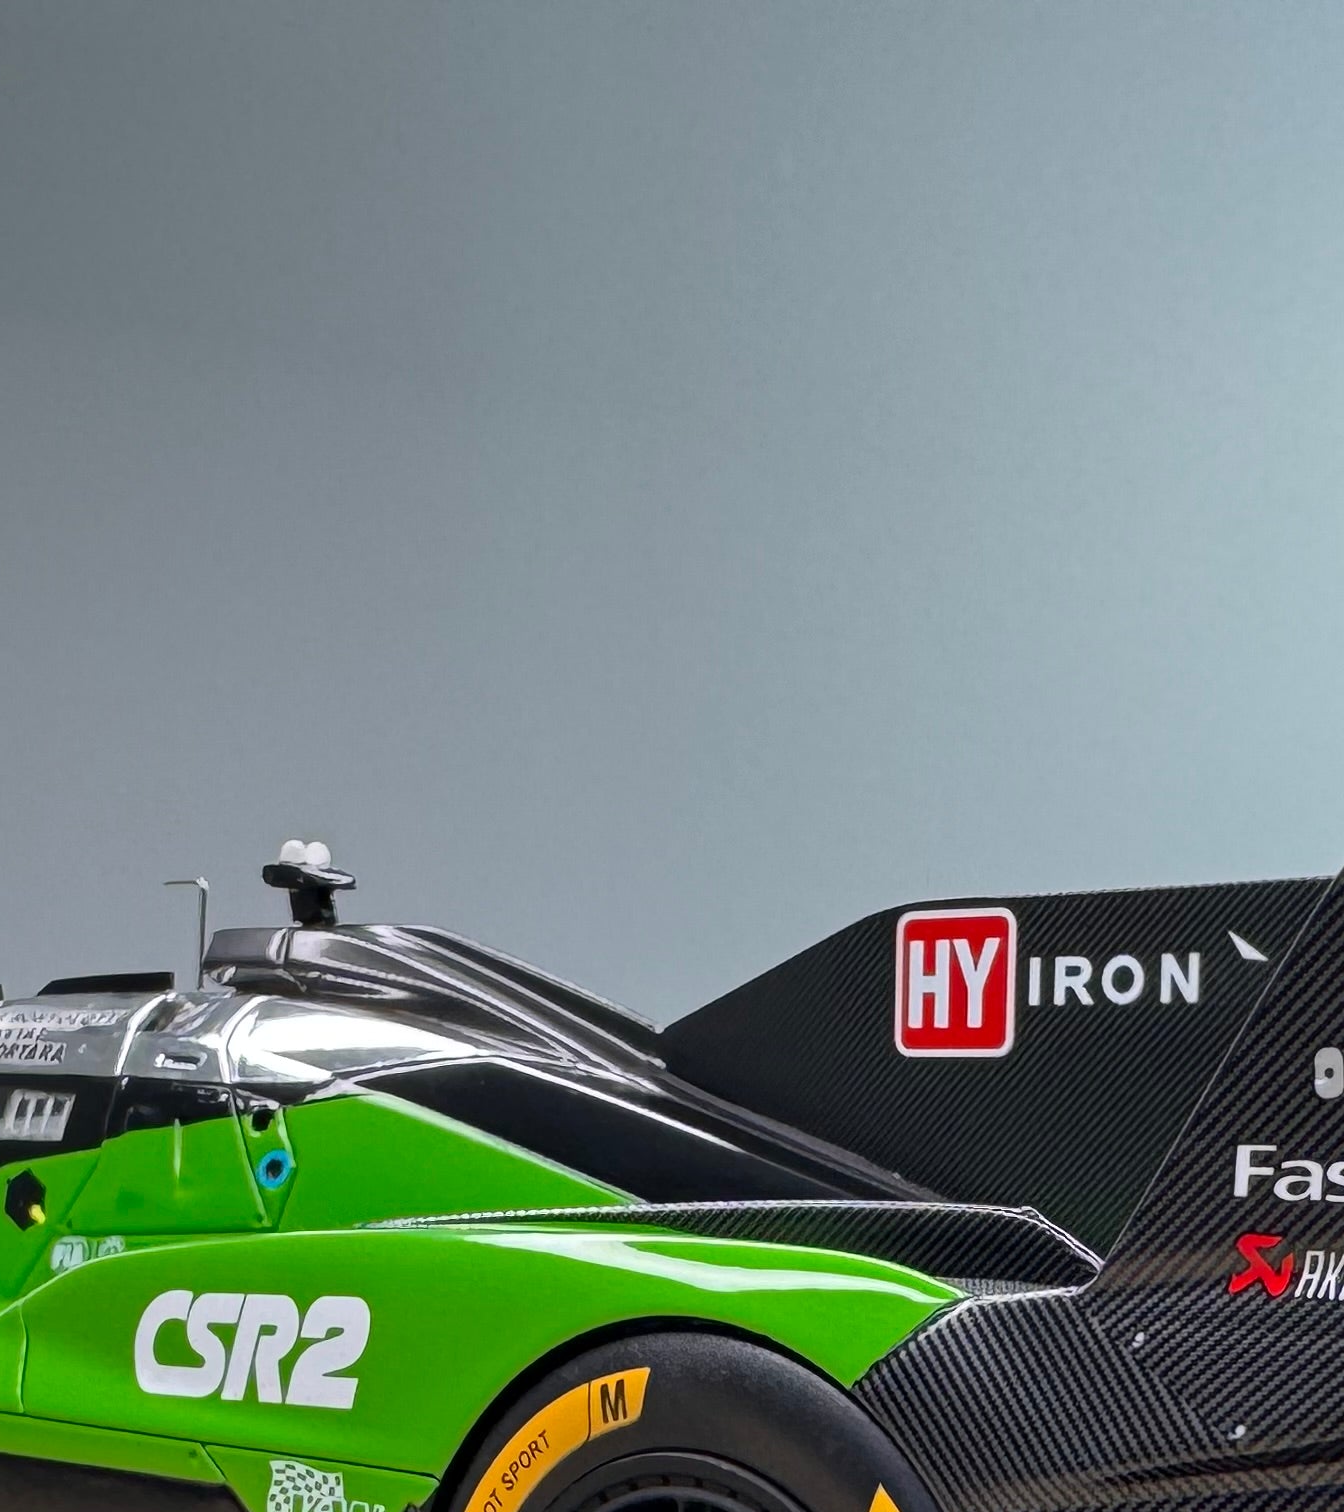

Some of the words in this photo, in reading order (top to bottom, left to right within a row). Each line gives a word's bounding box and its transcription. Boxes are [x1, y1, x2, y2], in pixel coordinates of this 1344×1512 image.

[907, 937, 1001, 1029] HY
[1028, 951, 1201, 1007] IRON
[134, 1289, 371, 1410] CSR2
[600, 1379, 628, 1424] M
[501, 1429, 551, 1491] SPORT
